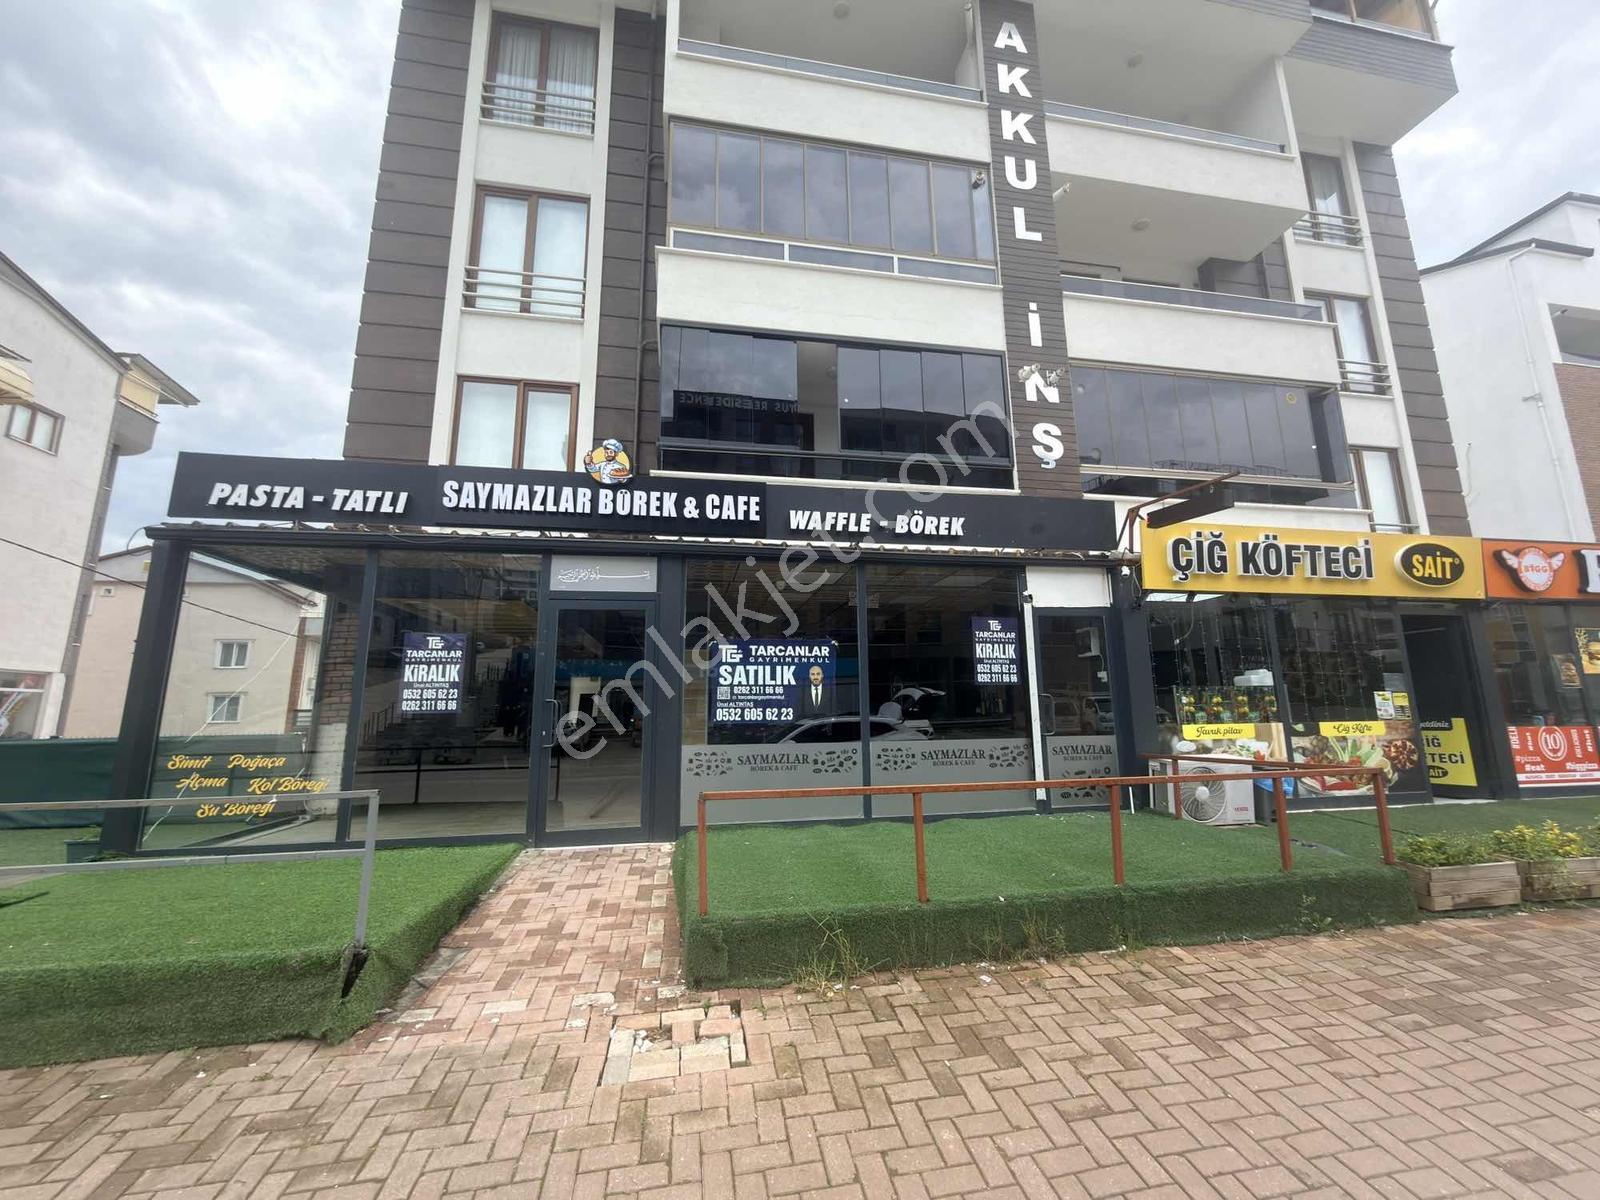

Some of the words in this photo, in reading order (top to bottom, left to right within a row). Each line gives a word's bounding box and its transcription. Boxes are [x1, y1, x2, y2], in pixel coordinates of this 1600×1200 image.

[994, 22, 1043, 242] AKKUL
[208, 482, 305, 509] PASTA
[331, 488, 409, 513] TATLI
[441, 480, 592, 514] SAYMAZLAR
[598, 488, 678, 518] BÖREK
[683, 496, 700, 519] &
[705, 493, 761, 521] CAFE
[789, 510, 872, 533] WAFFLE
[895, 510, 966, 536] BÖREK
[1170, 531, 1228, 581] ÇİĞ
[1240, 533, 1374, 579] KÖFTECİ
[1412, 551, 1453, 579] SAİT
[406, 650, 462, 658] TARCANLAR
[749, 645, 830, 657] TARCANLAR
[719, 665, 796, 686] SATILIK
[403, 689, 421, 699] 0532
[423, 689, 436, 699] 605
[438, 689, 447, 699] 62
[448, 689, 458, 699] 23
[734, 686, 750, 694] 0262
[752, 686, 763, 694] 311
[765, 686, 774, 694] 66
[775, 686, 784, 694] 66
[402, 701, 420, 711] 0262
[421, 701, 435, 711] 311
[437, 701, 446, 711] 66
[447, 701, 457, 711] 66
[716, 708, 741, 721] 0532
[744, 708, 763, 721] 605
[765, 708, 778, 721] 62
[781, 708, 793, 720] 23
[1424, 735, 1441, 748] İĞ
[921, 749, 986, 760] SAYMAZLAR
[1052, 745, 1113, 755] SAYMAZLAR
[167, 754, 213, 770] Simit
[228, 754, 288, 771] Poğaça
[737, 753, 809, 765] SAYMAZLAR
[176, 772, 229, 790] Açma
[247, 778, 277, 795] Kol
